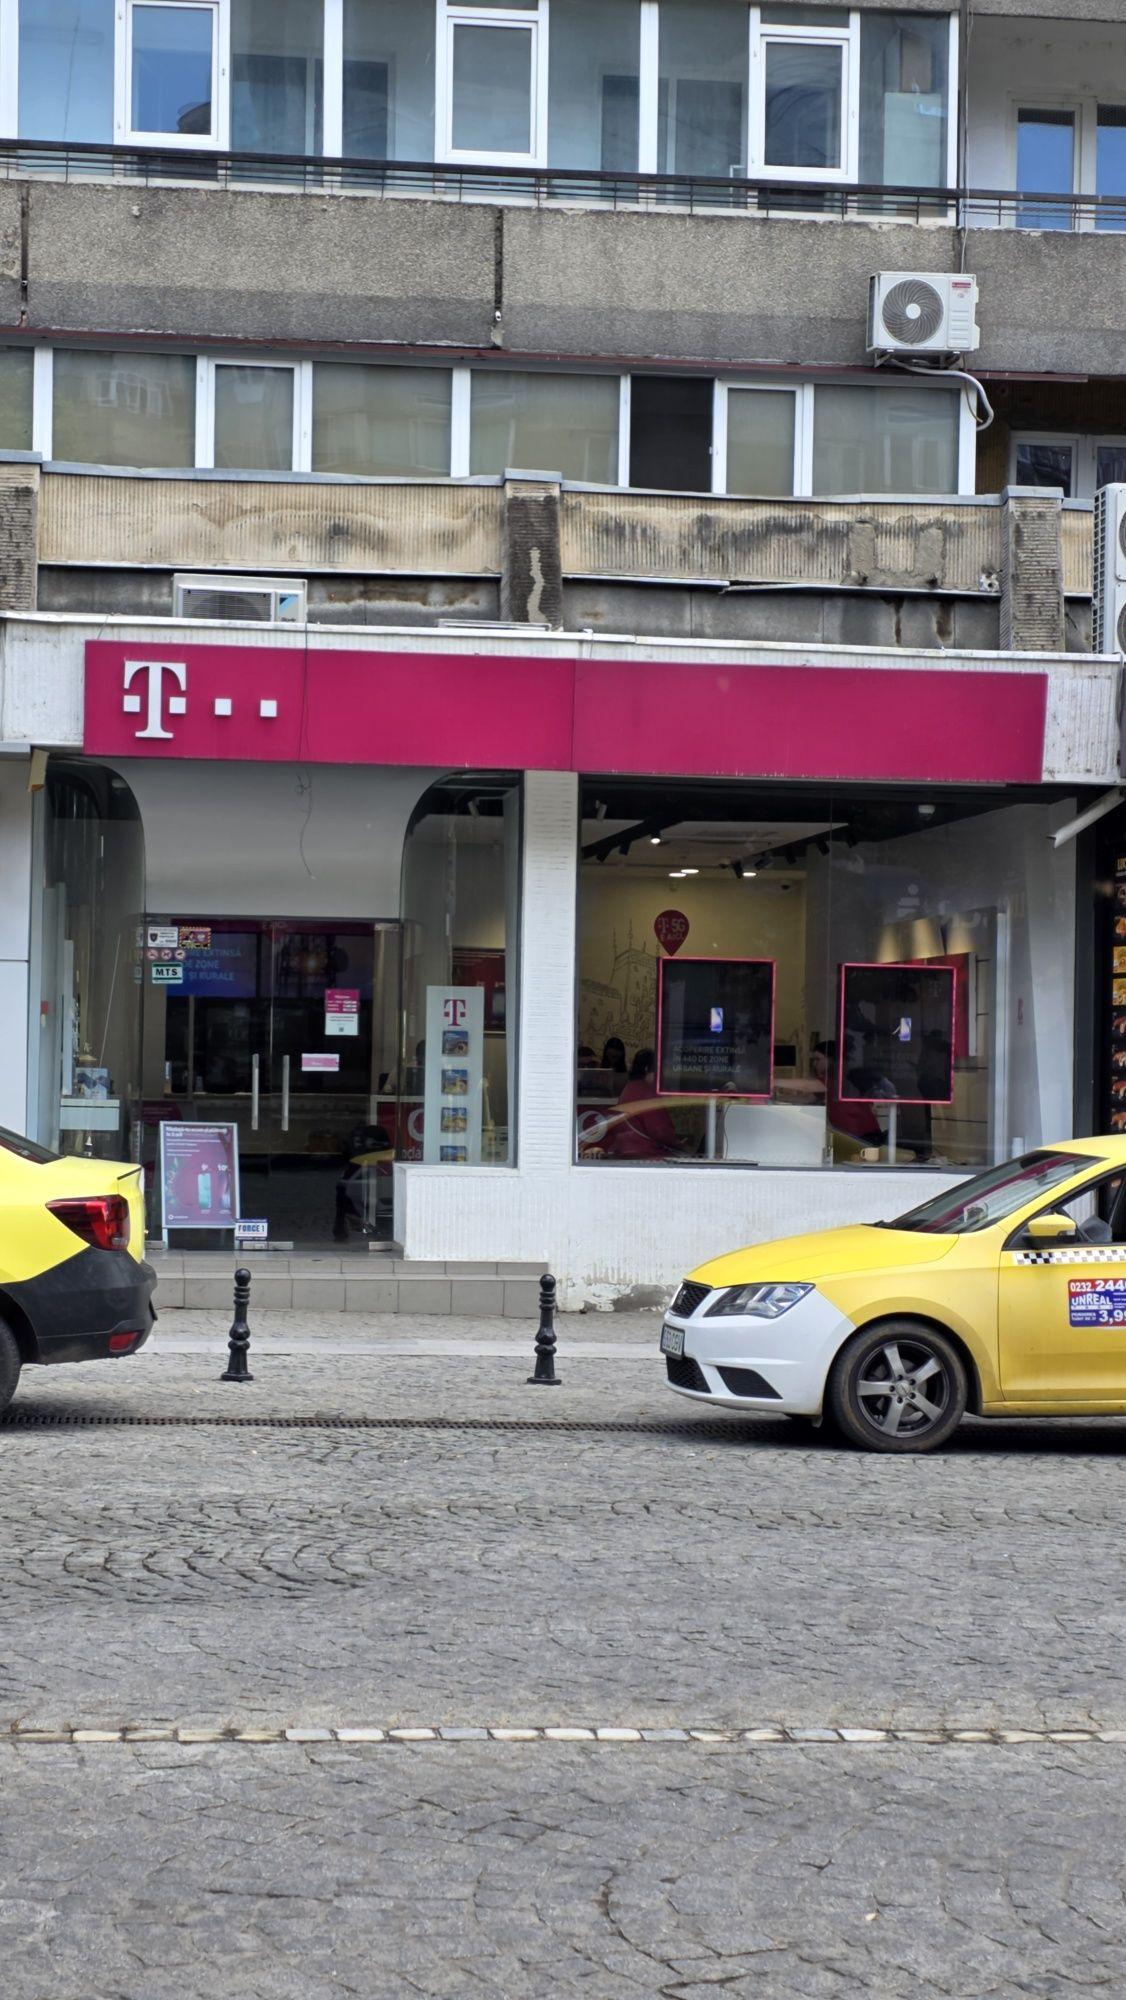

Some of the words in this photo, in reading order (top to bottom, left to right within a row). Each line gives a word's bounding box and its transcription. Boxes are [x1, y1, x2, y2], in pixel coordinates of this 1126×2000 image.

[123, 660, 187, 739] T
[443, 999, 466, 1026] T
[238, 1224, 260, 1232] FORCE
[1095, 1279, 1126, 1292] 244
[1071, 1293, 1112, 1305] UNREAL
